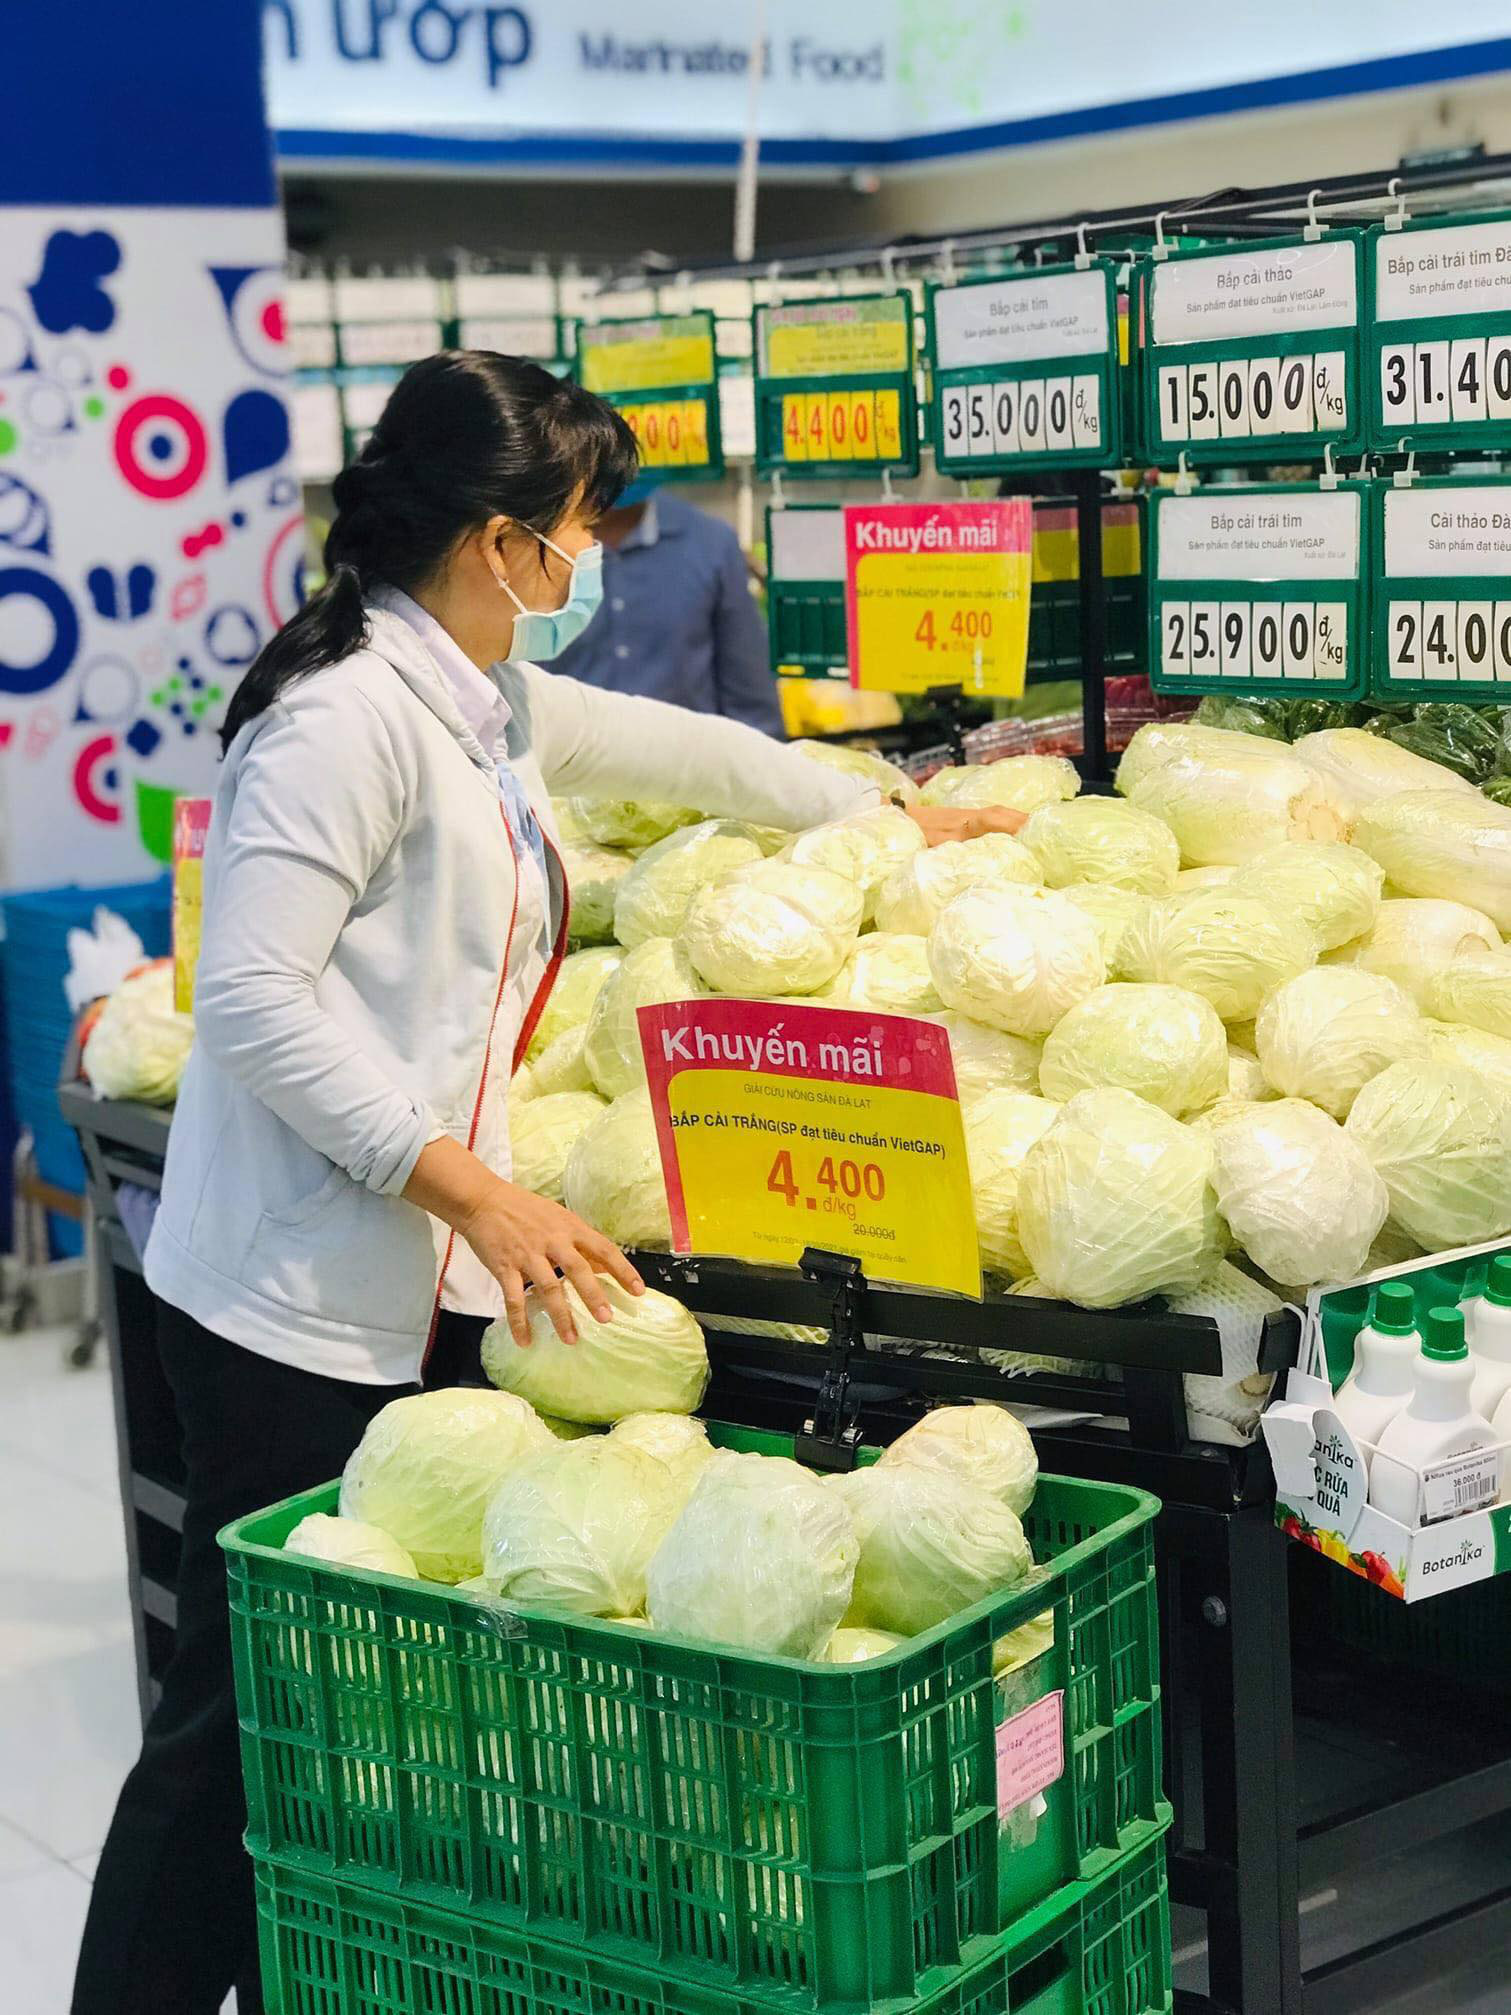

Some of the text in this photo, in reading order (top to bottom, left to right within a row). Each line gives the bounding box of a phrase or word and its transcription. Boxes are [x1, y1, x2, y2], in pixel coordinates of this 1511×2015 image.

[793, 38, 884, 83] Food
[1264, 265, 1293, 283] thảo
[1388, 256, 1414, 276] Bắp
[1418, 254, 1439, 271] cải
[1442, 251, 1465, 268] trái
[1289, 288, 1326, 301] VietGAP
[1457, 279, 1472, 291] đạt
[1168, 362, 1305, 424] 15.000
[949, 390, 1066, 440] 35.000
[855, 515, 998, 554] Khuyến mãi
[1210, 513, 1234, 532] Bắp
[1258, 514, 1279, 528] trái
[1431, 511, 1452, 528] Cải
[1456, 512, 1488, 529] thảo
[1289, 538, 1325, 549] VietGAP
[915, 610, 992, 652] 4.400
[1168, 612, 1309, 663] 25.900
[661, 1022, 884, 1077] Khuyến mãi
[787, 1088, 815, 1102] NÔNG
[669, 1110, 700, 1128] BẮP
[704, 1111, 729, 1127] CẢI
[800, 1124, 819, 1142] đạt
[823, 1128, 846, 1143] tiêu
[849, 1132, 887, 1148] chuẩn
[889, 1136, 946, 1160] VietGAP)
[767, 1149, 886, 1211] 4.400
[1314, 1440, 1354, 1470] anika
[1324, 1471, 1348, 1498] RỬA
[1317, 1490, 1340, 1516] QUẢ
[1422, 1545, 1482, 1575] Botanika
